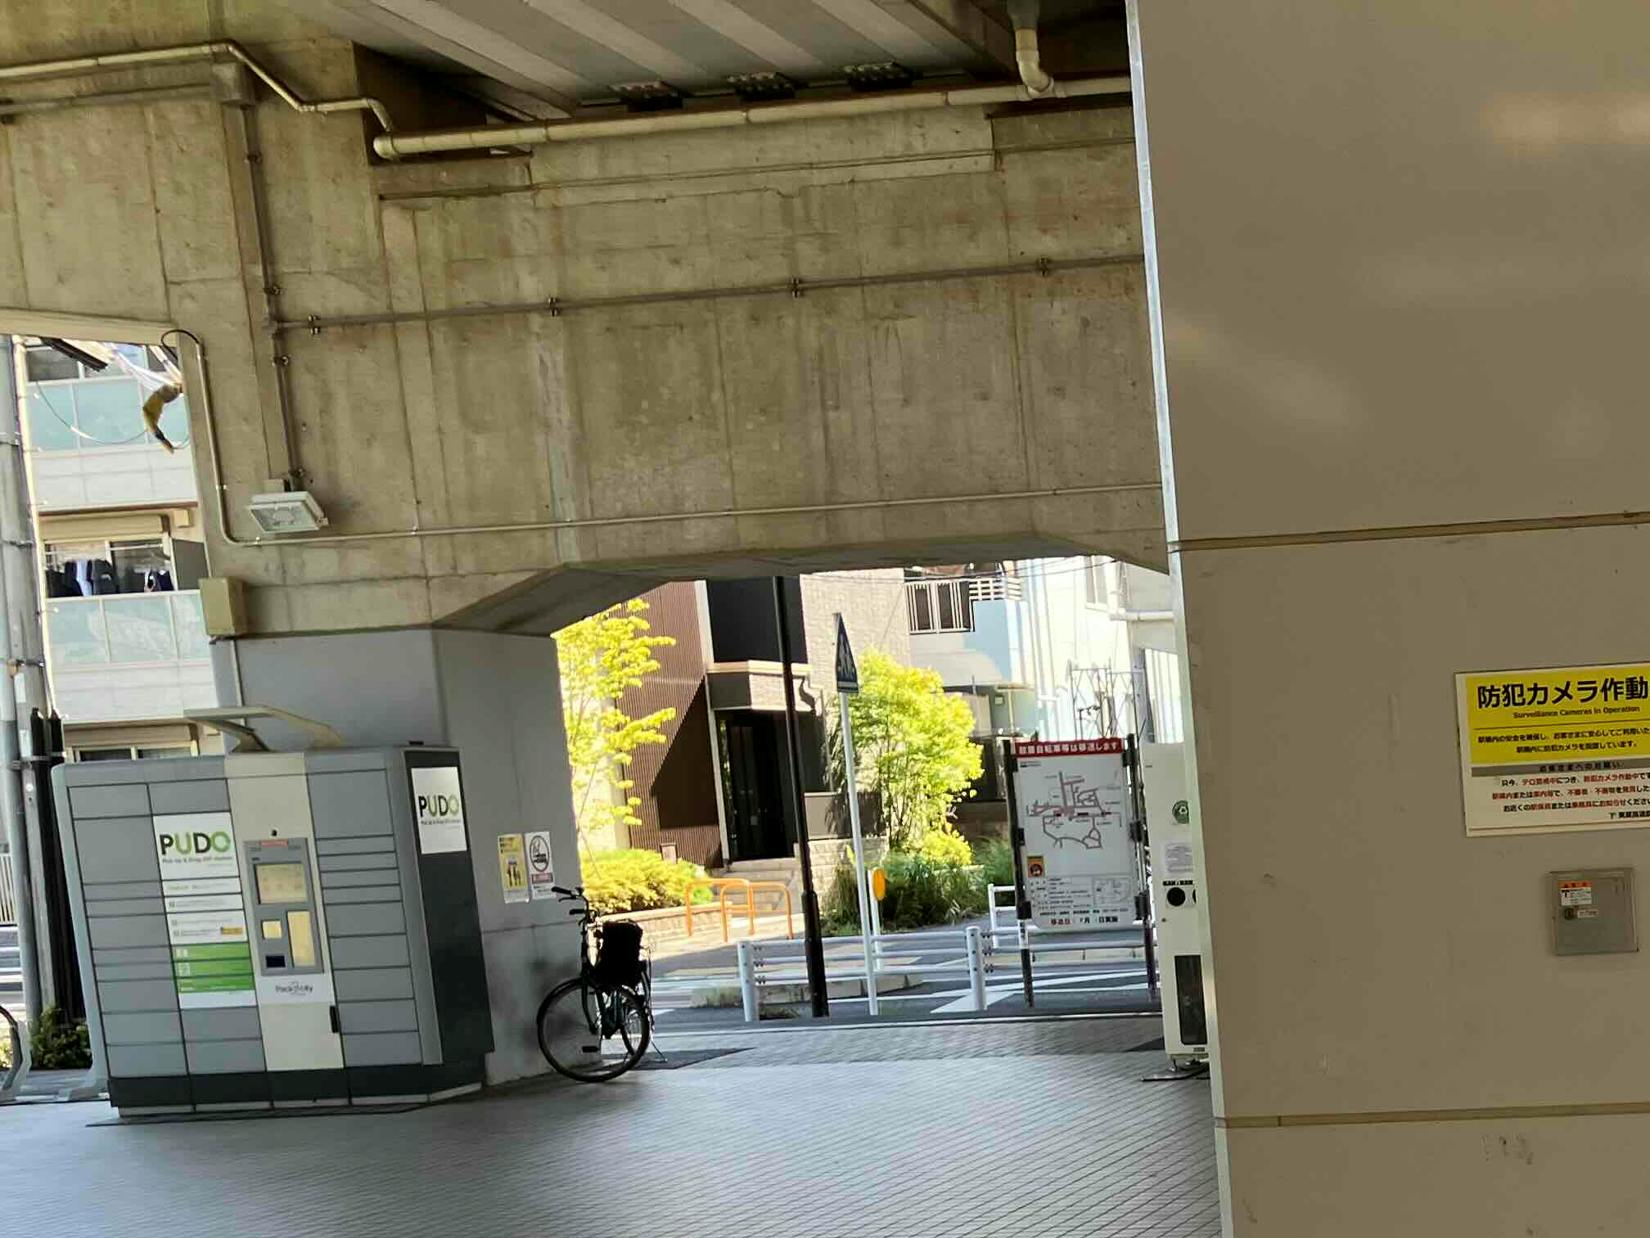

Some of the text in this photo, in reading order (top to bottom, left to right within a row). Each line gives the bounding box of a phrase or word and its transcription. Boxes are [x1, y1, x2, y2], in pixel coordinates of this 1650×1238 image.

[1559, 708, 1592, 717] Cameras
[1602, 705, 1640, 715] Operation
[418, 795, 459, 817] PUDO
[159, 831, 231, 855] PUDO
